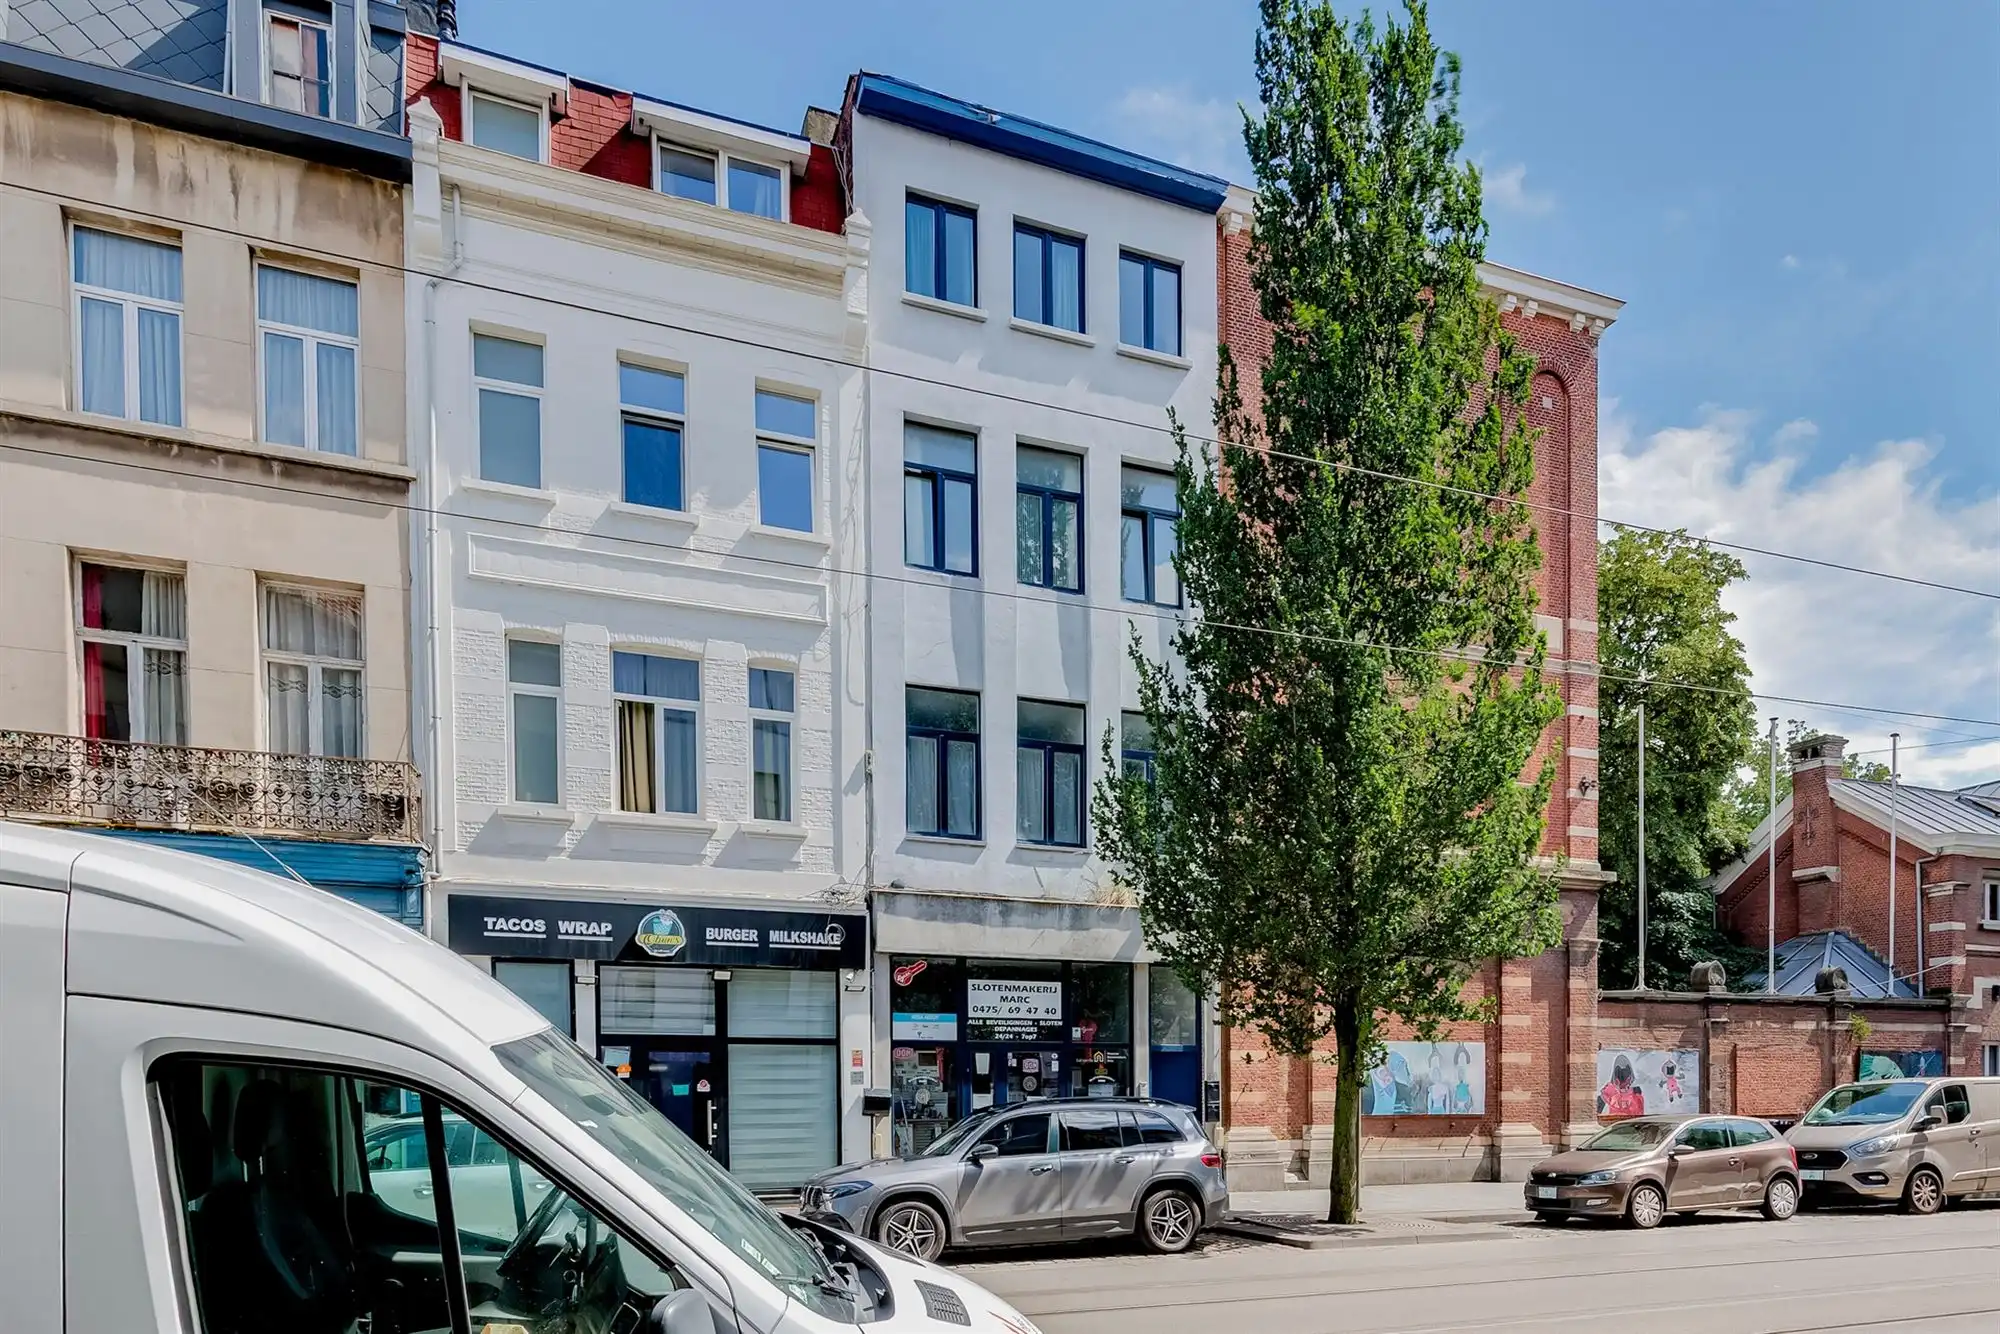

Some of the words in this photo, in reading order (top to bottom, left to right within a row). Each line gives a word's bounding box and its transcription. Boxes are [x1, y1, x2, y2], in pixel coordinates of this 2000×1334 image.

[484, 916, 547, 933] TACOS
[557, 920, 613, 935] WRAP
[706, 927, 759, 942] BURGER
[769, 930, 842, 945] MILKSHAKE
[971, 983, 1058, 994] SLOTENMAKERIJ
[1000, 995, 1031, 1004] MARC
[972, 1005, 1002, 1015] 0475/
[1008, 1006, 1021, 1014] 69
[1044, 1007, 1057, 1015] 40
[986, 1019, 1033, 1027] BEVEILIGINGEN
